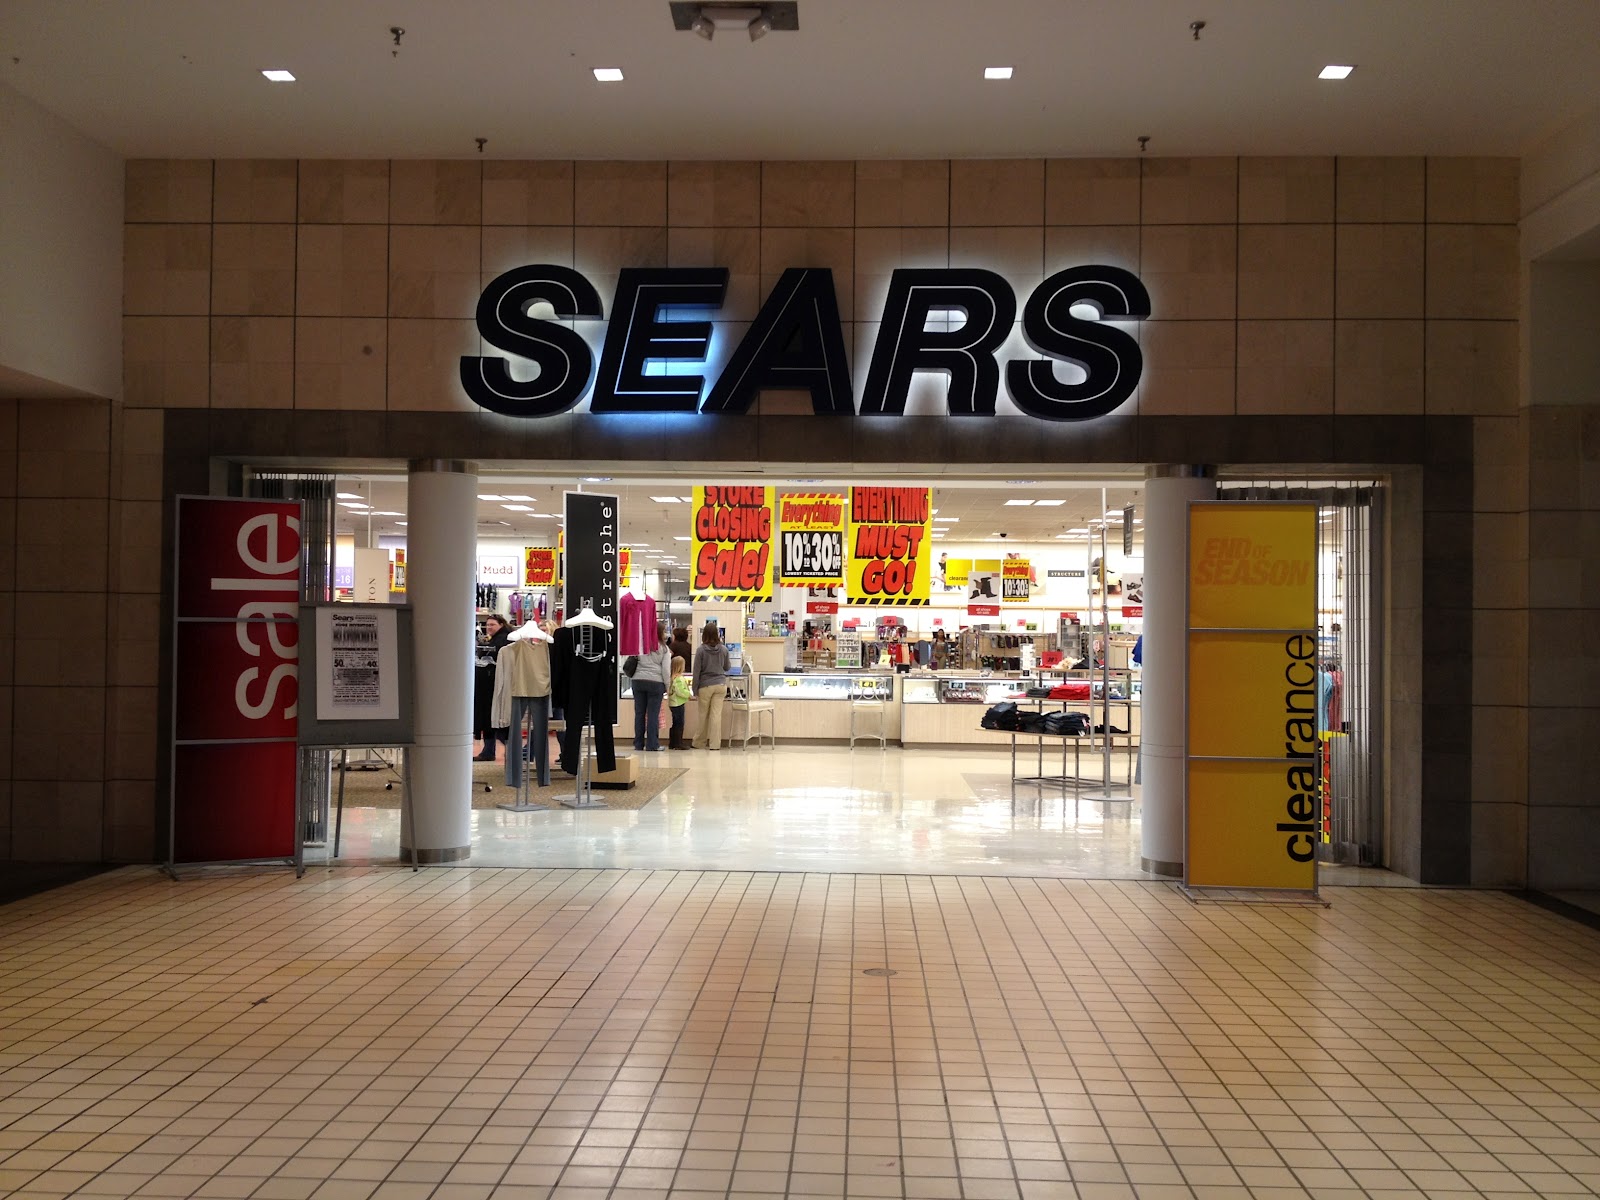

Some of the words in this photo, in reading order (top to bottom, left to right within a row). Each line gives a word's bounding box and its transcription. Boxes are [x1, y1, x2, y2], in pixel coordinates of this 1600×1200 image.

[460, 264, 1151, 422] SEARS
[696, 506, 770, 543] CLOSING
[781, 500, 842, 527] Everything
[852, 487, 928, 525] EVERYTHING
[855, 525, 924, 560] MUST
[483, 566, 513, 575] Mudd
[694, 541, 769, 591] Sale!
[862, 560, 916, 596] GO!
[1194, 559, 1311, 587] SEASON
[210, 513, 300, 720] sale
[1276, 634, 1316, 863] clearance
